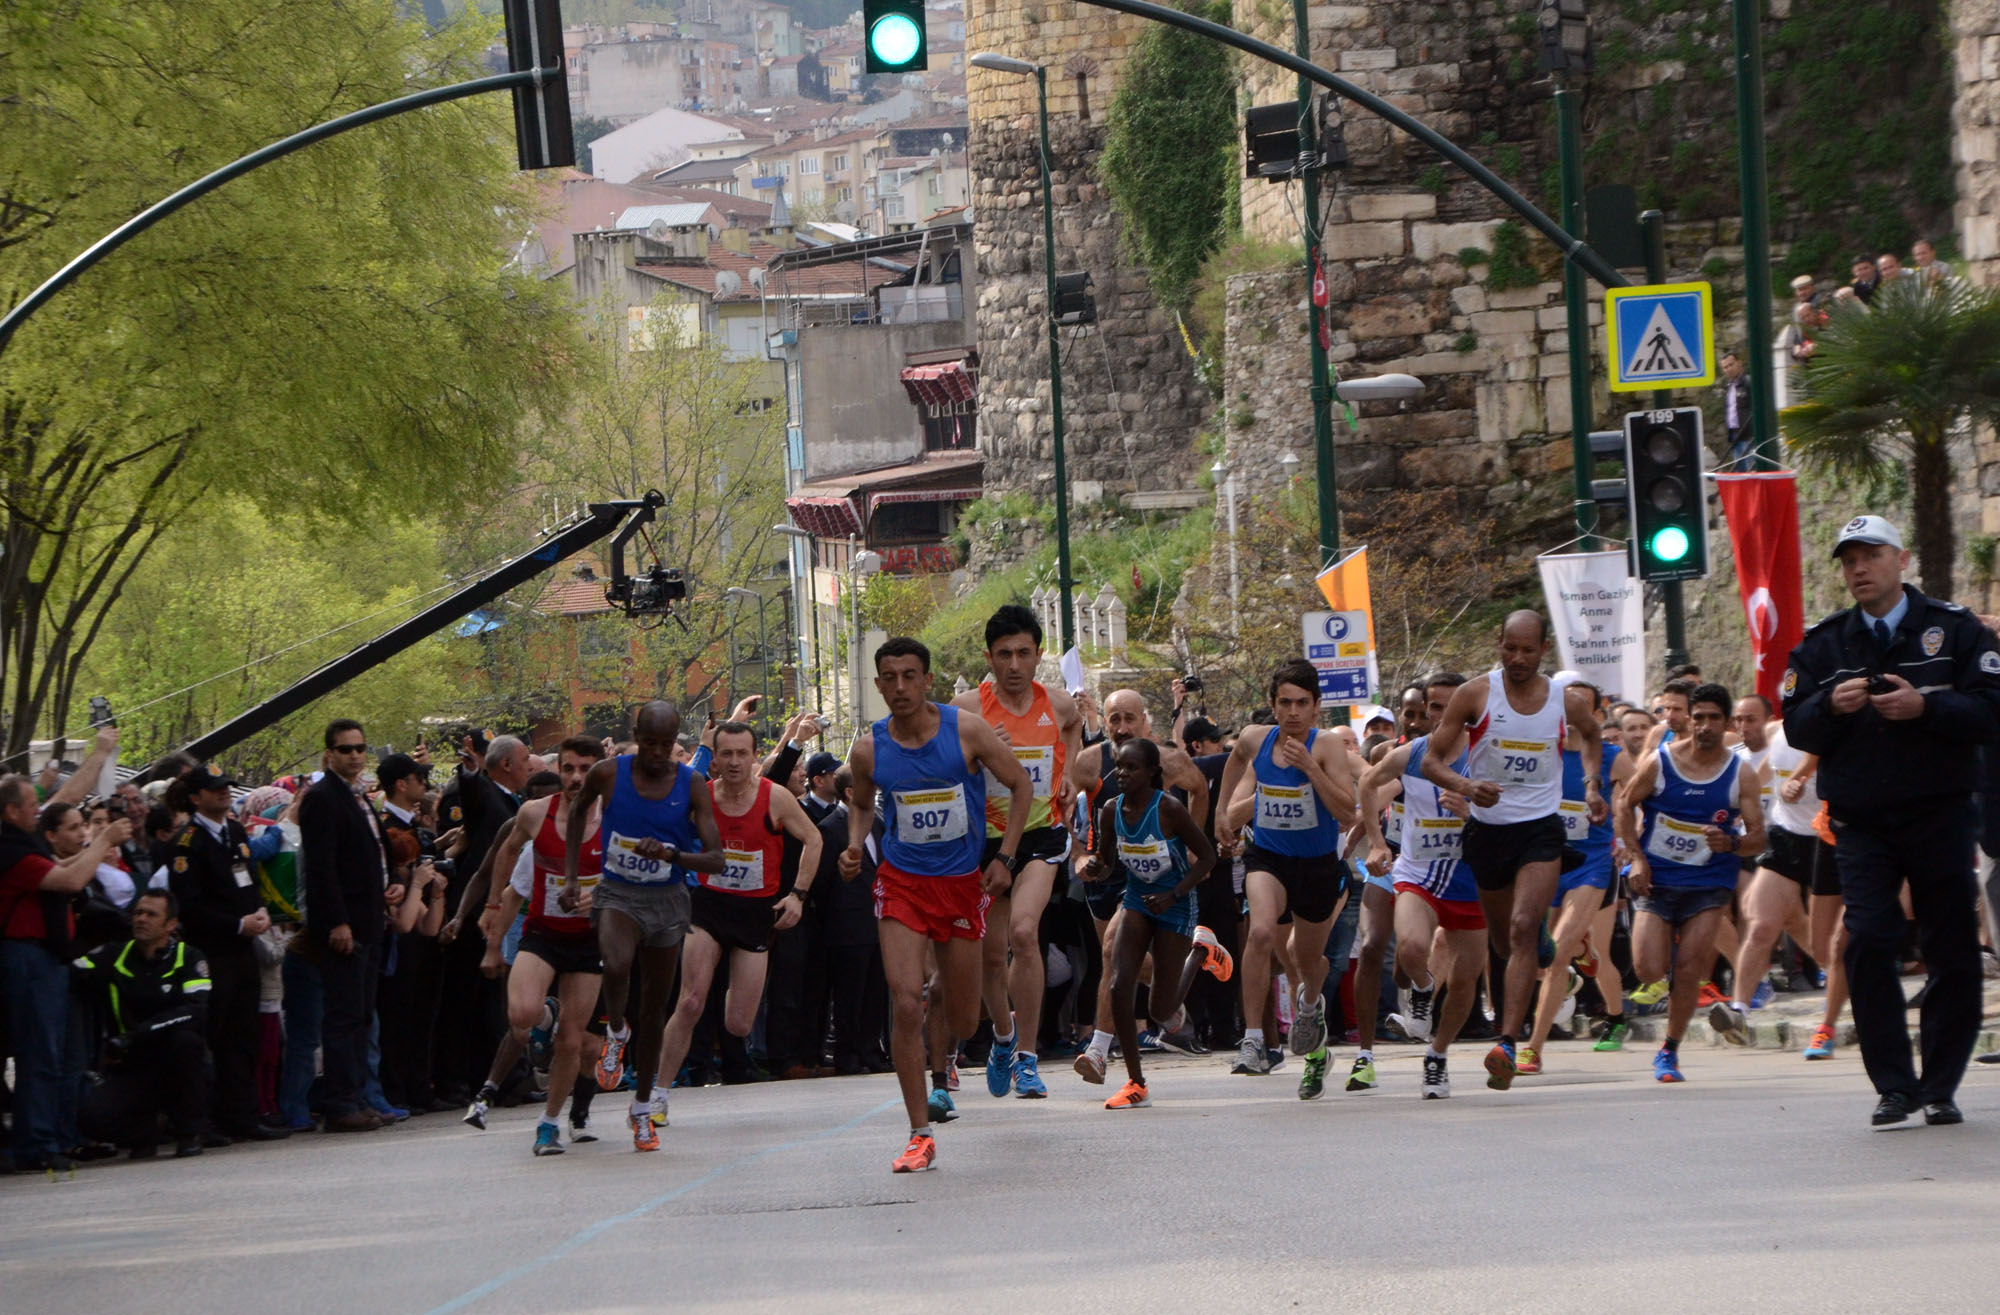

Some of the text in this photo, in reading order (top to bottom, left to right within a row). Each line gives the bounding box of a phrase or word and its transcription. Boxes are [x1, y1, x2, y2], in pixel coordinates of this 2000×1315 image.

[1647, 410, 1674, 424] 199
[1580, 607, 1613, 617] Anma
[1592, 625, 1604, 633] ve
[1503, 755, 1538, 773] 790
[1264, 801, 1305, 819] 1125
[912, 808, 950, 830] 807
[1421, 832, 1464, 849] 1147
[1665, 834, 1698, 853] 499
[617, 853, 660, 875] 1300
[1125, 858, 1161, 873] 1299
